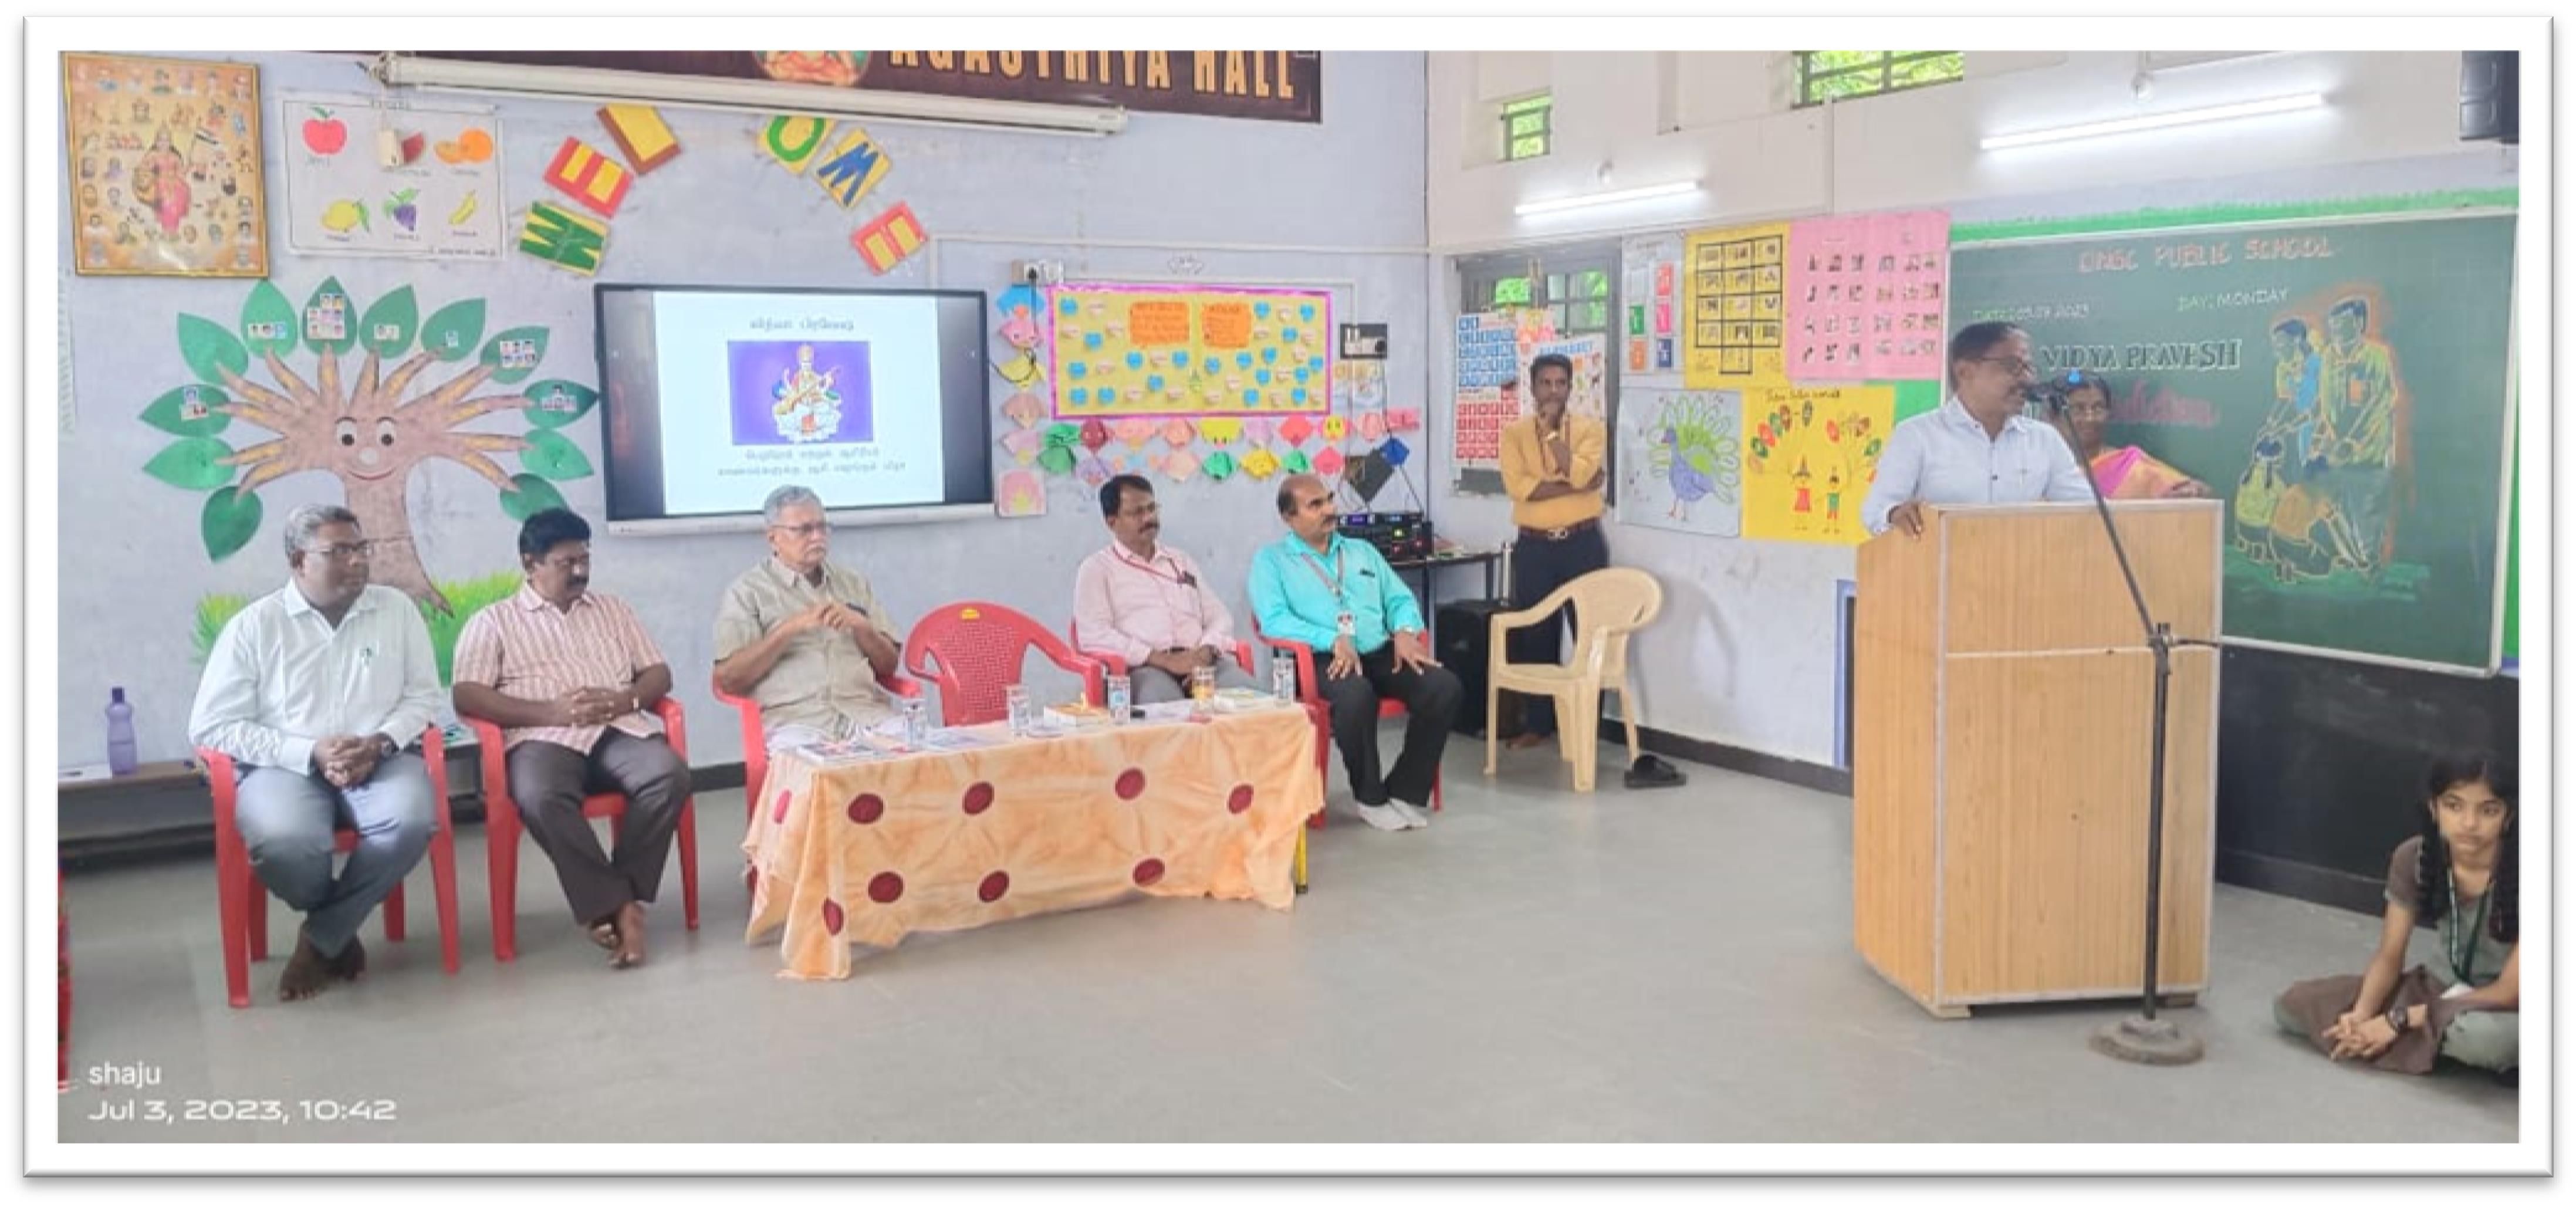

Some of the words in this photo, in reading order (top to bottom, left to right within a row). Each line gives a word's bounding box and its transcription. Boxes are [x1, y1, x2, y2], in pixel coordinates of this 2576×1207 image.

[1194, 50, 1294, 99] HALL
[2154, 241, 2231, 268] PUBLIC
[2244, 234, 2334, 260] SCHOOL
[2039, 344, 2121, 372] VIDYA
[2125, 338, 2243, 373] PRAVESH
